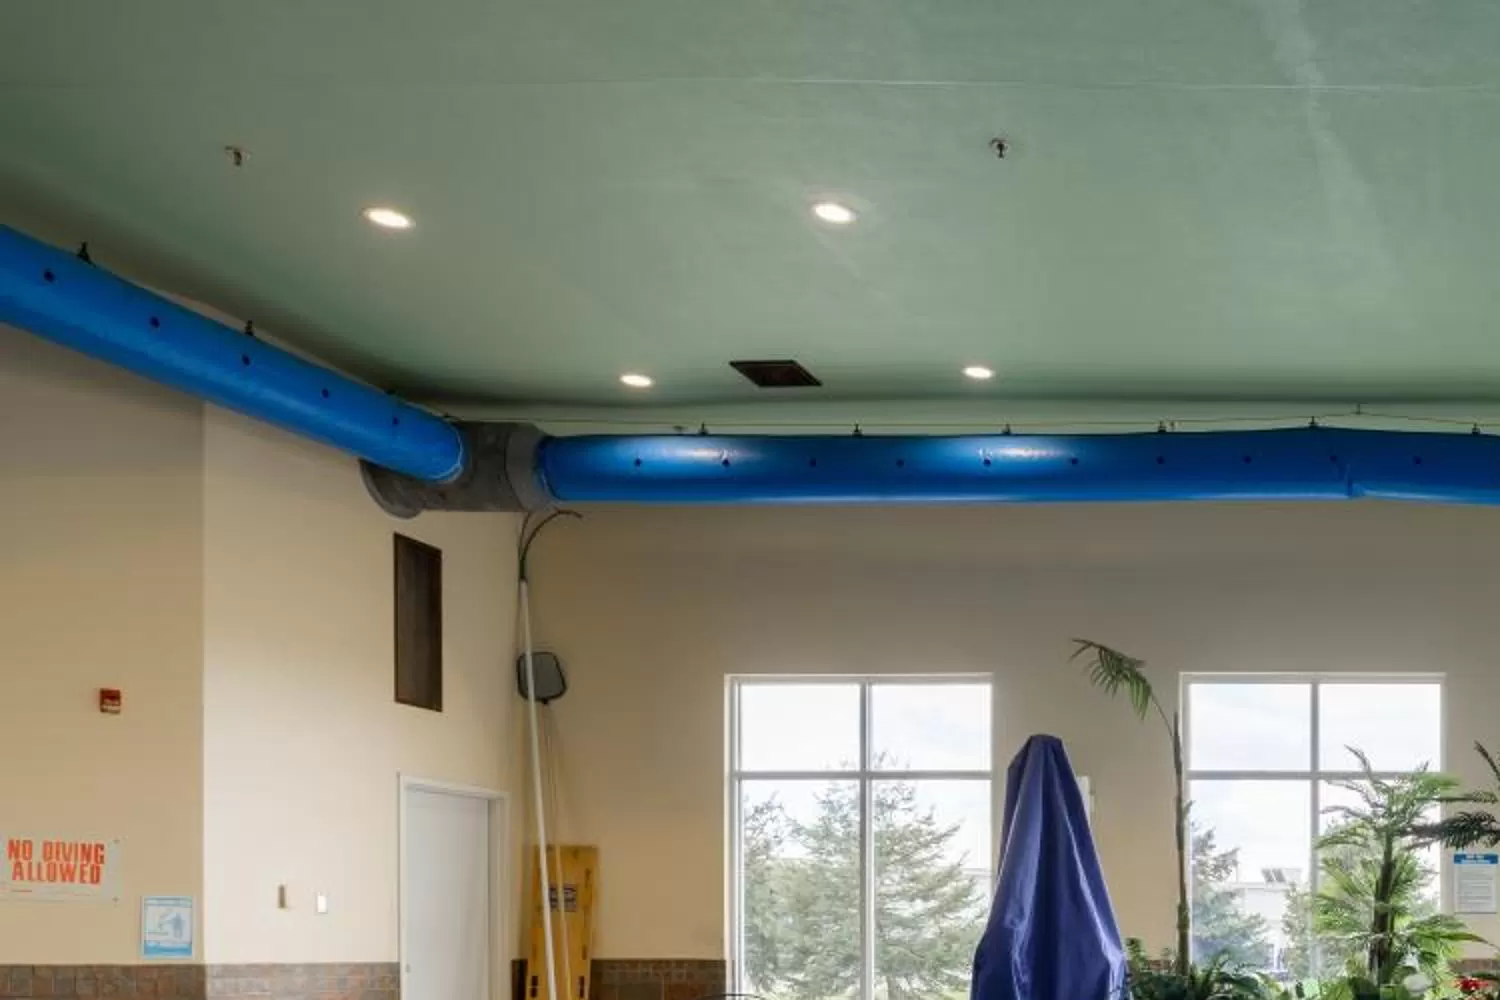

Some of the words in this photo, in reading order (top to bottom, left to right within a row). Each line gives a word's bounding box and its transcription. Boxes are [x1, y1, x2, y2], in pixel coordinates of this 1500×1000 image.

[8, 839, 33, 861] NO
[43, 841, 105, 865] DIVING
[12, 862, 101, 884] ALLOWED
